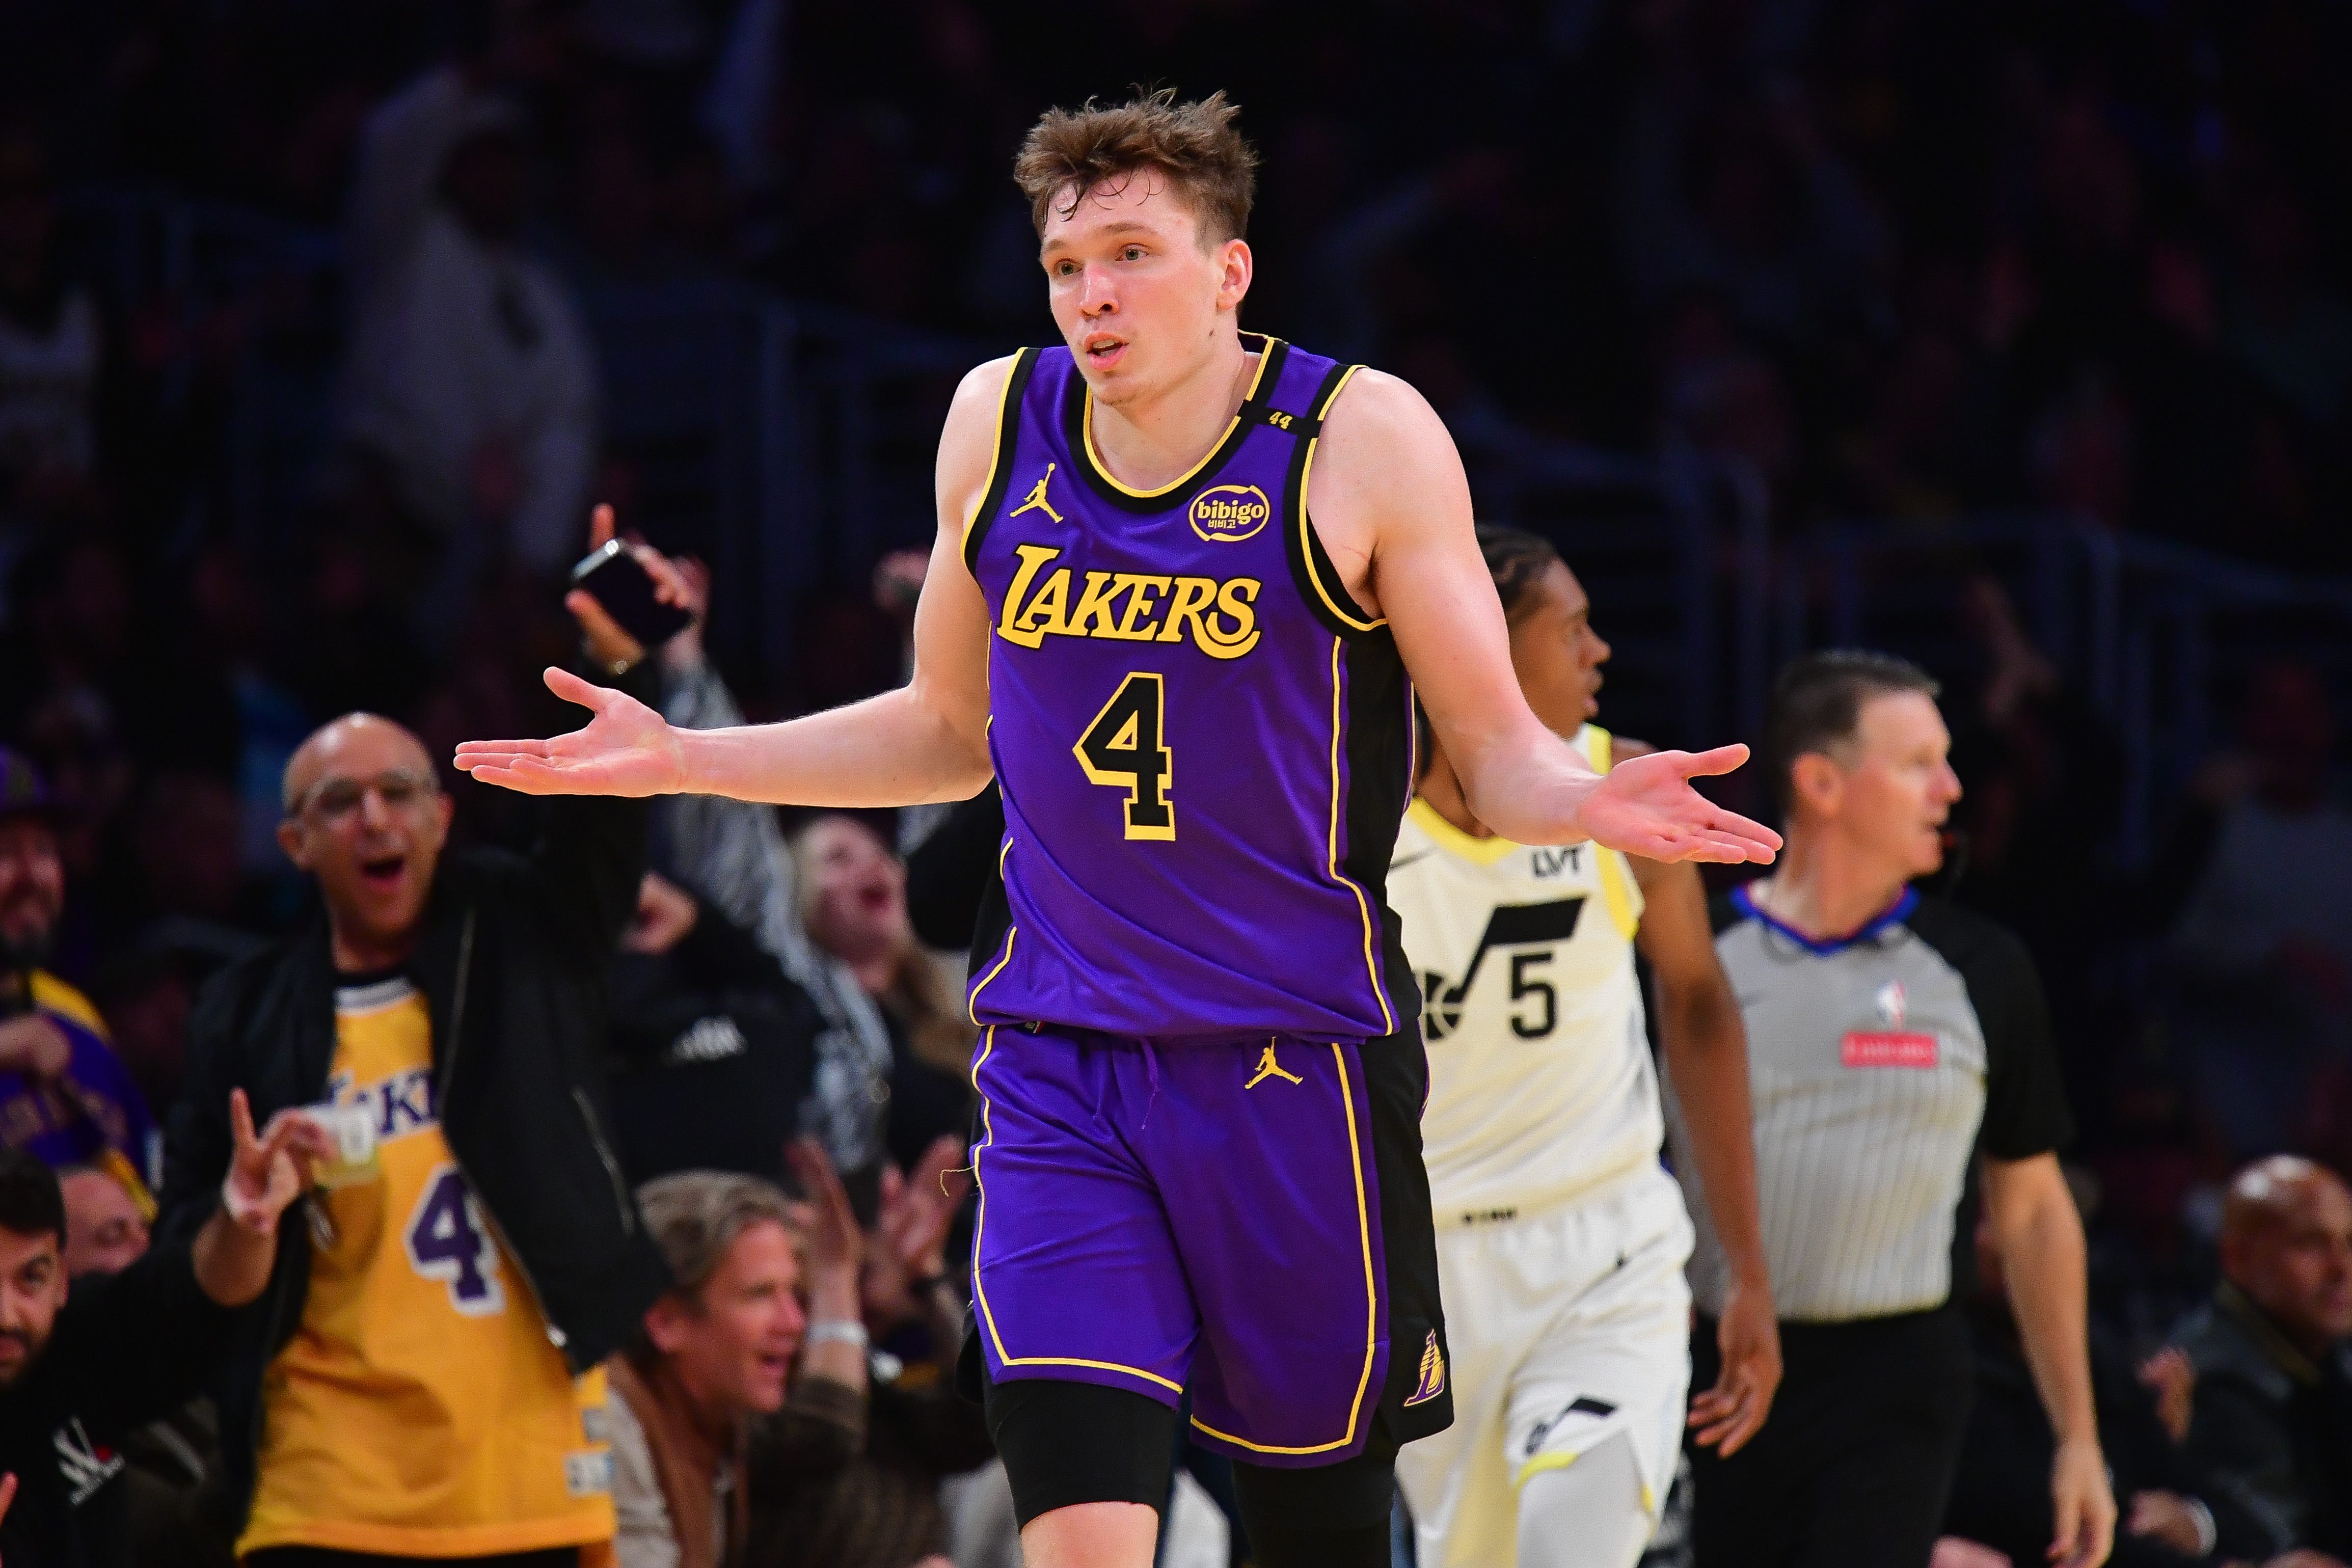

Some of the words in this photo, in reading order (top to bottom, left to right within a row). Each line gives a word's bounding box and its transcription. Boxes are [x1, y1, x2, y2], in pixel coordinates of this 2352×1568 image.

[1269, 412, 1293, 429] 44
[1198, 500, 1265, 525] bibigo
[1207, 519, 1236, 529] 비비고
[997, 545, 1262, 660] LAKERS
[1072, 672, 1176, 842] 4
[1511, 952, 1555, 1038] 5
[405, 1164, 504, 1315] 4
